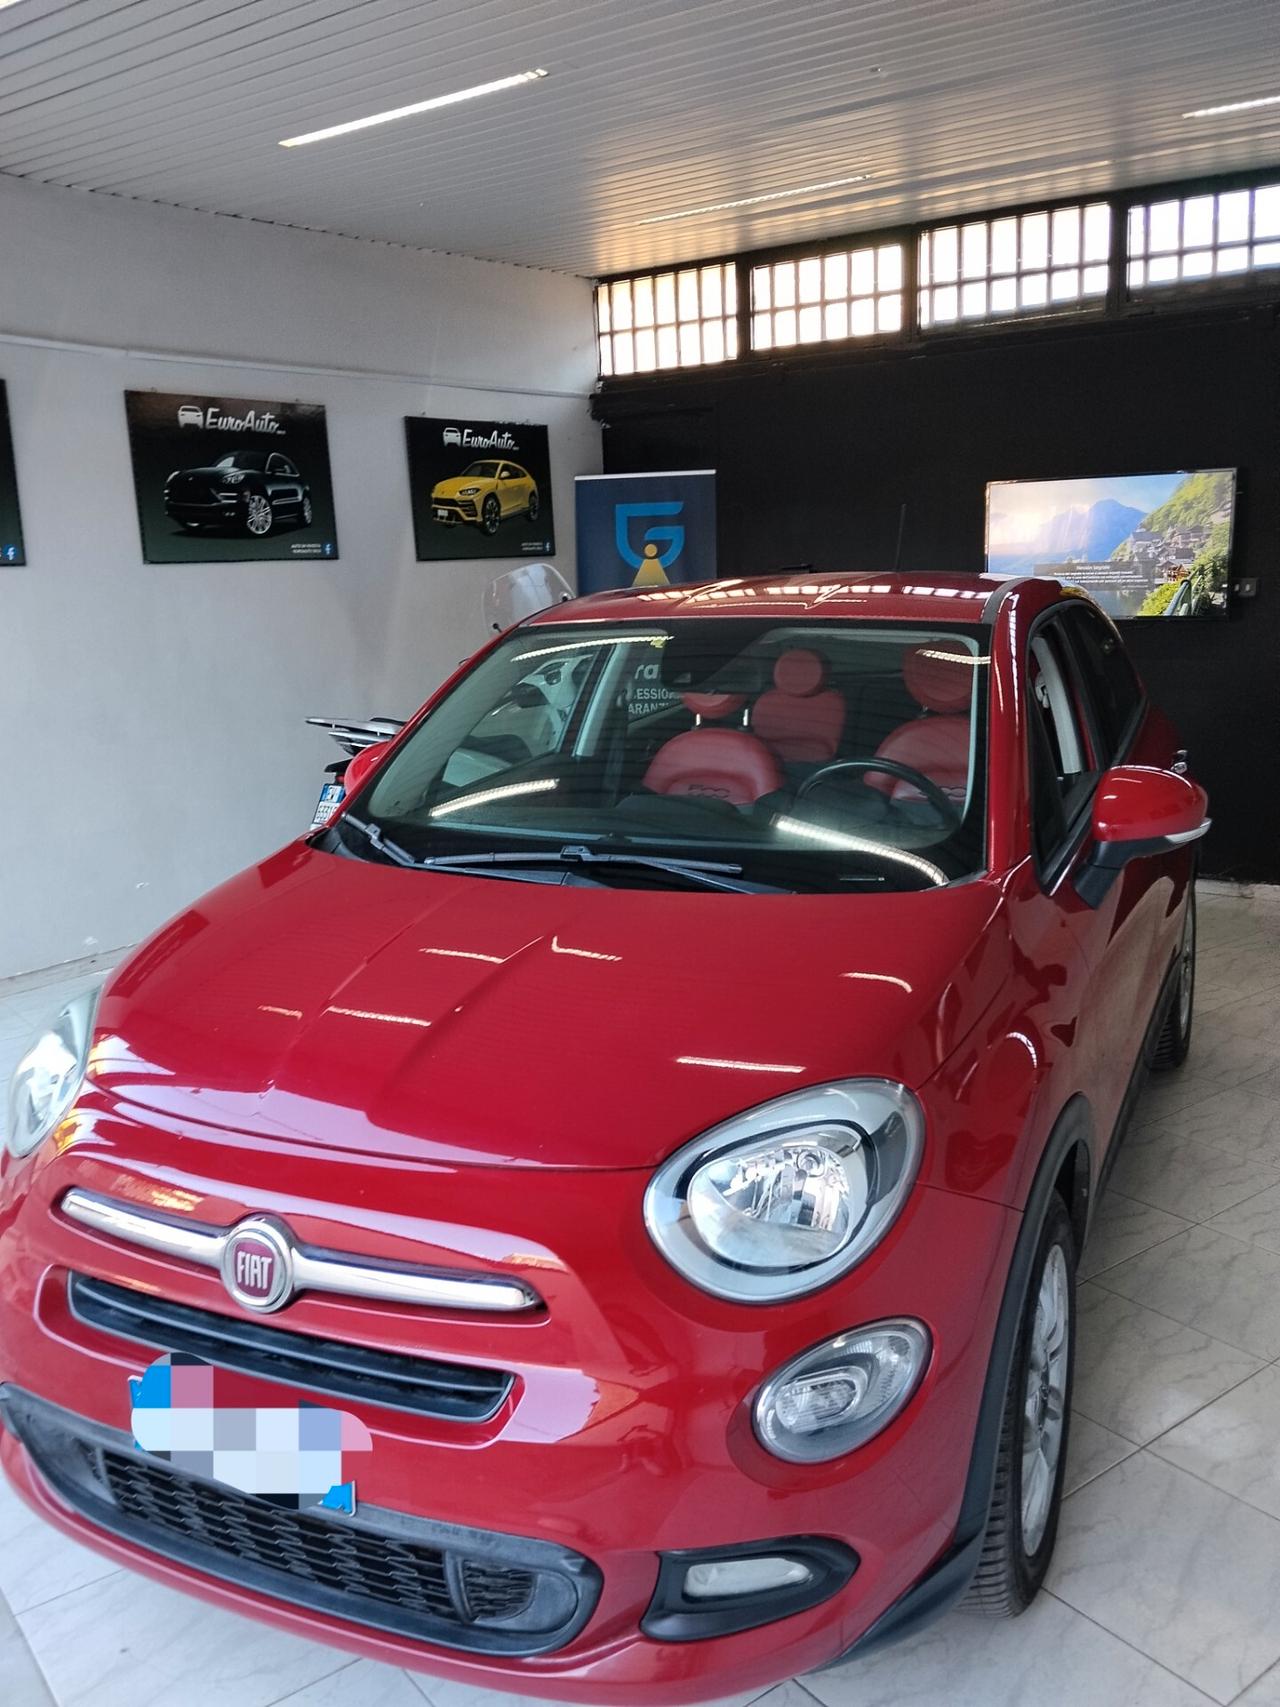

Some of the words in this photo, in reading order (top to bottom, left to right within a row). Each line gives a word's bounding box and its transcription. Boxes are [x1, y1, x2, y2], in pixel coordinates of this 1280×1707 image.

[206, 407, 280, 433] EuroAuto
[463, 428, 515, 449] EuroAuto
[237, 1250, 273, 1290] FIAT
